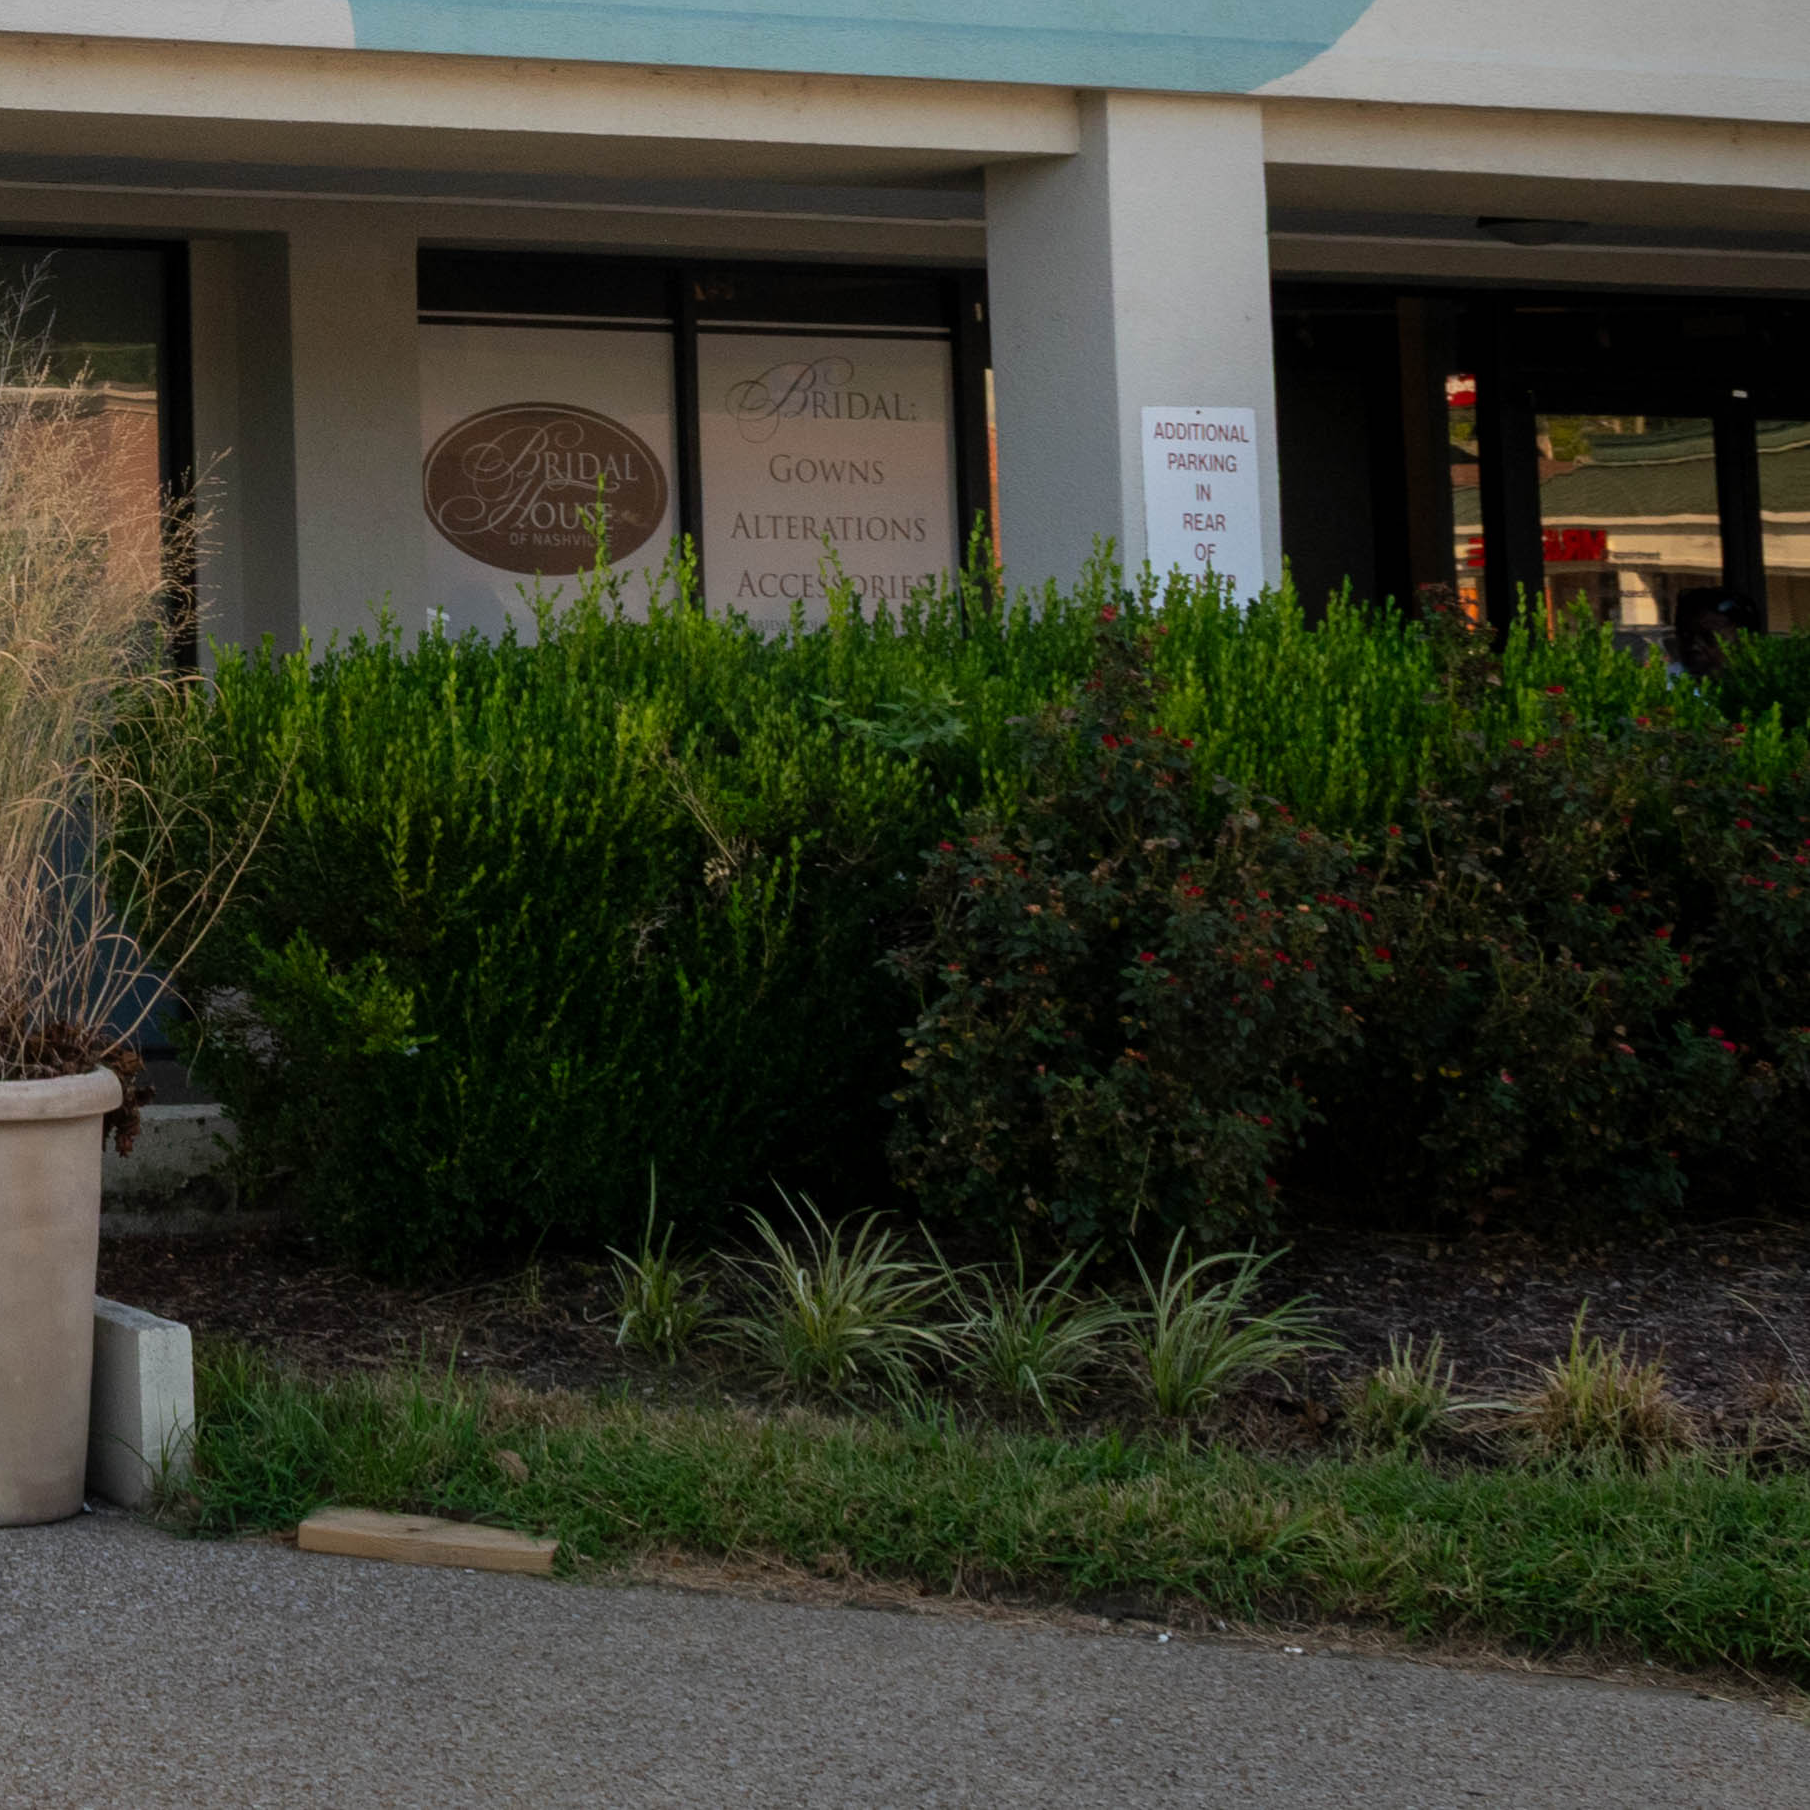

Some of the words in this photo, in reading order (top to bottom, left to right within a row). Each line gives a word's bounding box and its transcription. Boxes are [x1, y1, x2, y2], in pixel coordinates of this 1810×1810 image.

[1153, 421, 1250, 443] ADDITIONAL
[461, 420, 639, 502] BRIDAL
[768, 453, 885, 485] GOWNS
[1167, 452, 1238, 473] PARKING
[1195, 483, 1212, 502] IN
[730, 512, 927, 542] ALTERATIONS
[1182, 513, 1227, 532] REAR
[509, 532, 528, 546] OF
[532, 533, 613, 548] NASHVILE
[1194, 542, 1217, 561] OF
